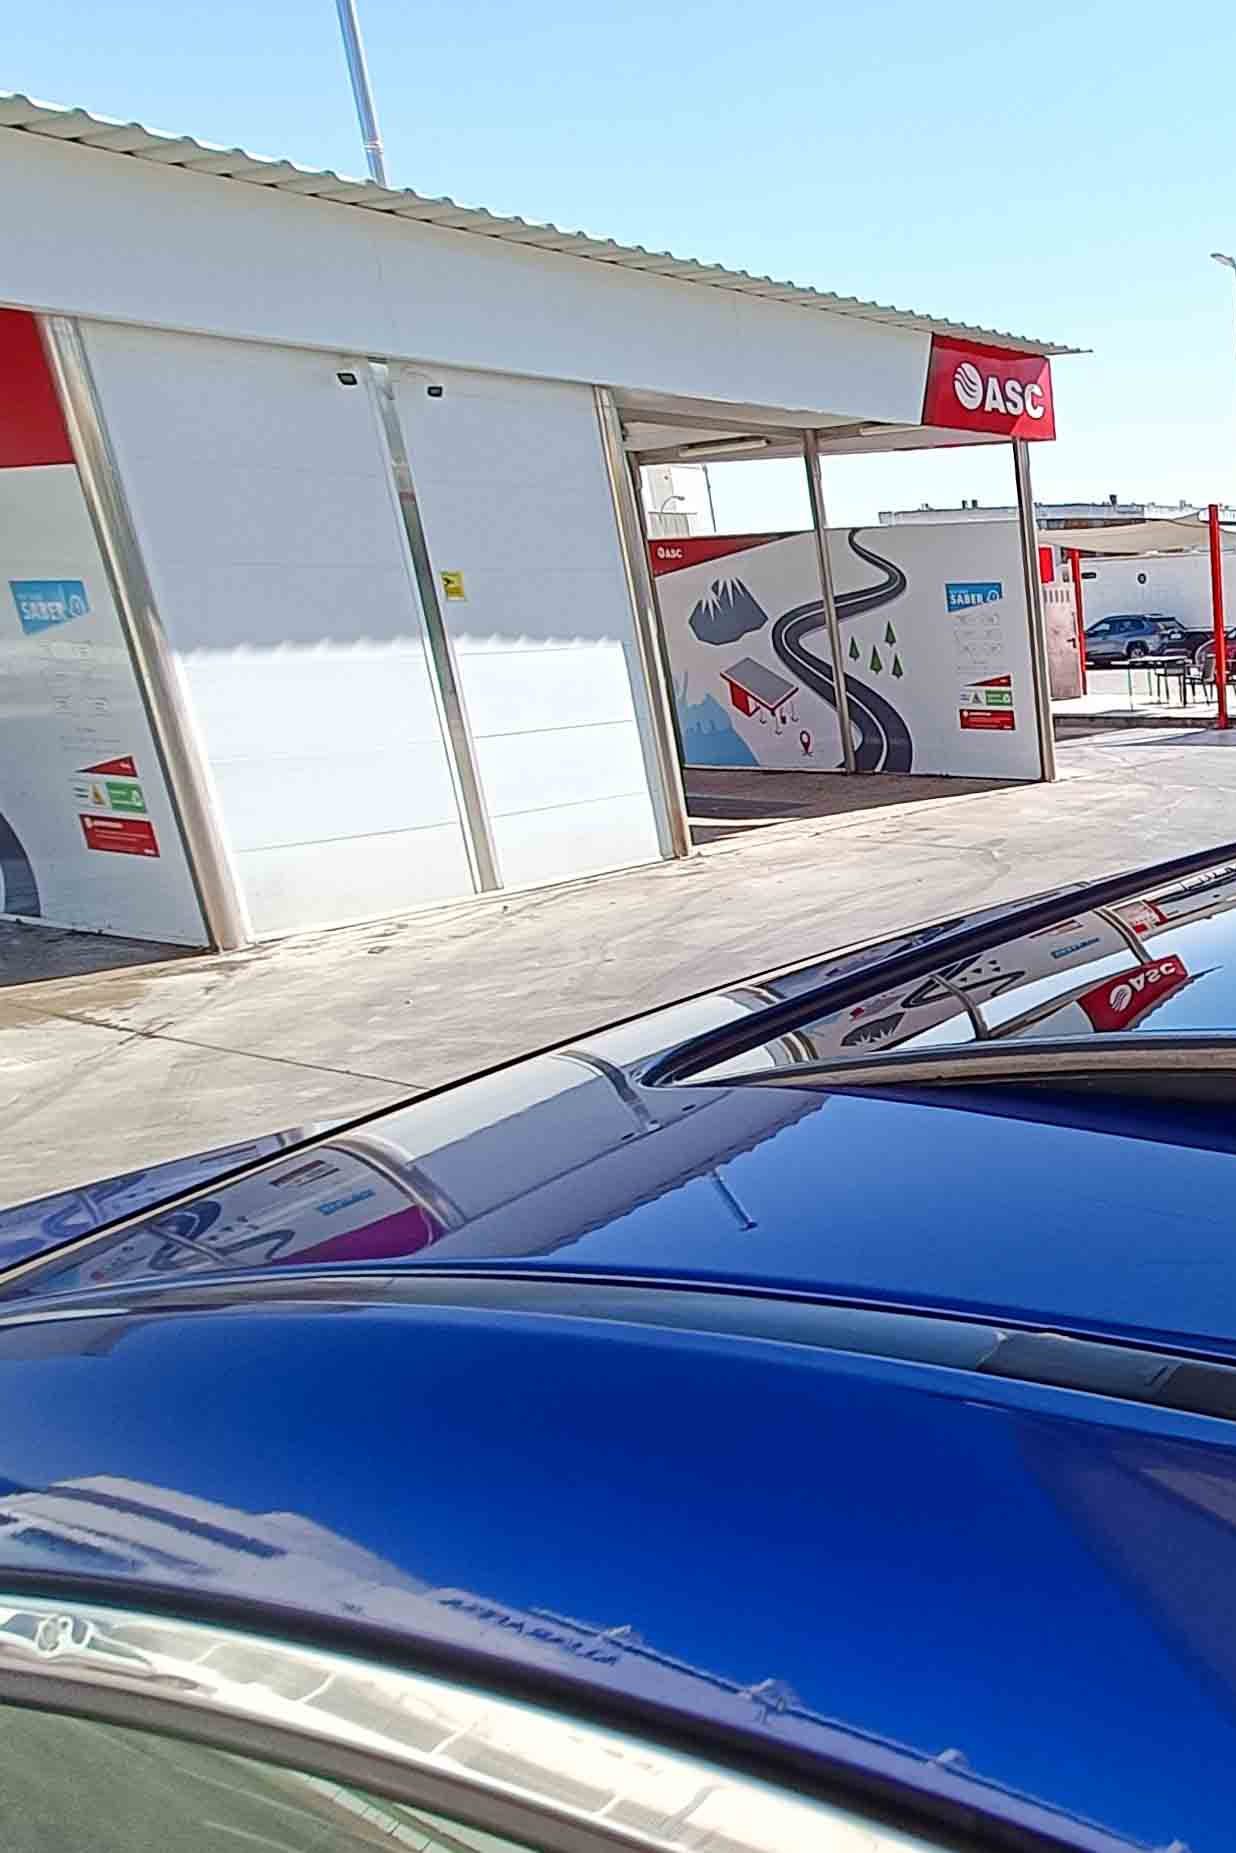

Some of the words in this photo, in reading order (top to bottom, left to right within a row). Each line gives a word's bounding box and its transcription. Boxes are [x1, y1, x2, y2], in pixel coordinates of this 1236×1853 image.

[984, 376, 1045, 419] ASC
[665, 547, 683, 559] ASC
[950, 591, 984, 605] SABER
